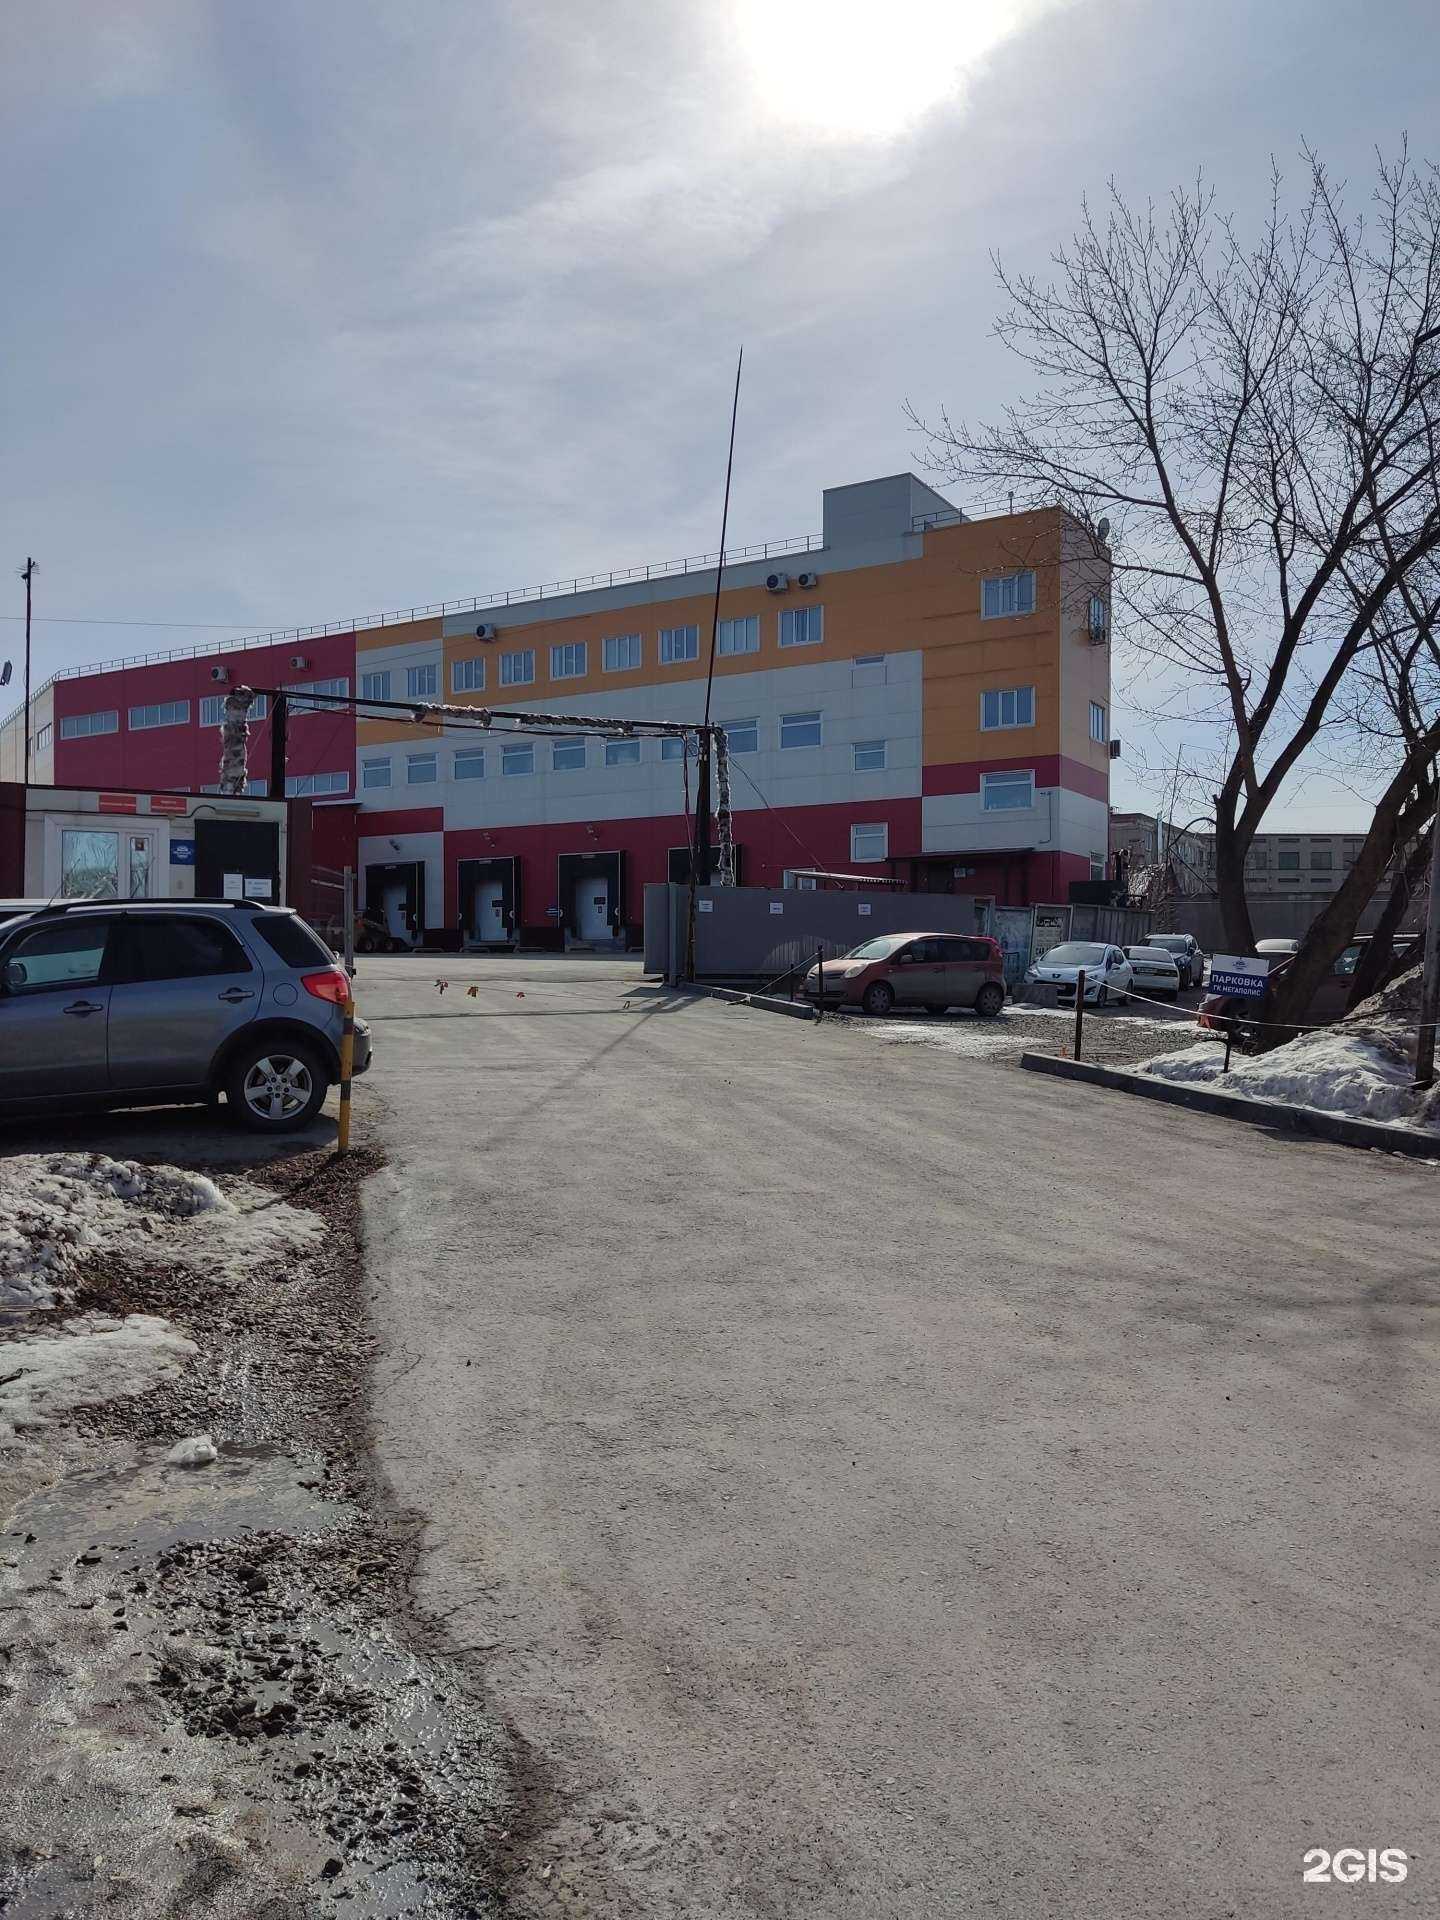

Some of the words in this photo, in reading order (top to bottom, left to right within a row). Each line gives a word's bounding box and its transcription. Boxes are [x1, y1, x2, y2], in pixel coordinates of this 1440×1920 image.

[1212, 974, 1264, 988] ПАРКОВКА
[1213, 984, 1222, 992] ГК
[1222, 985, 1262, 997] МЕГАПОЛИС
